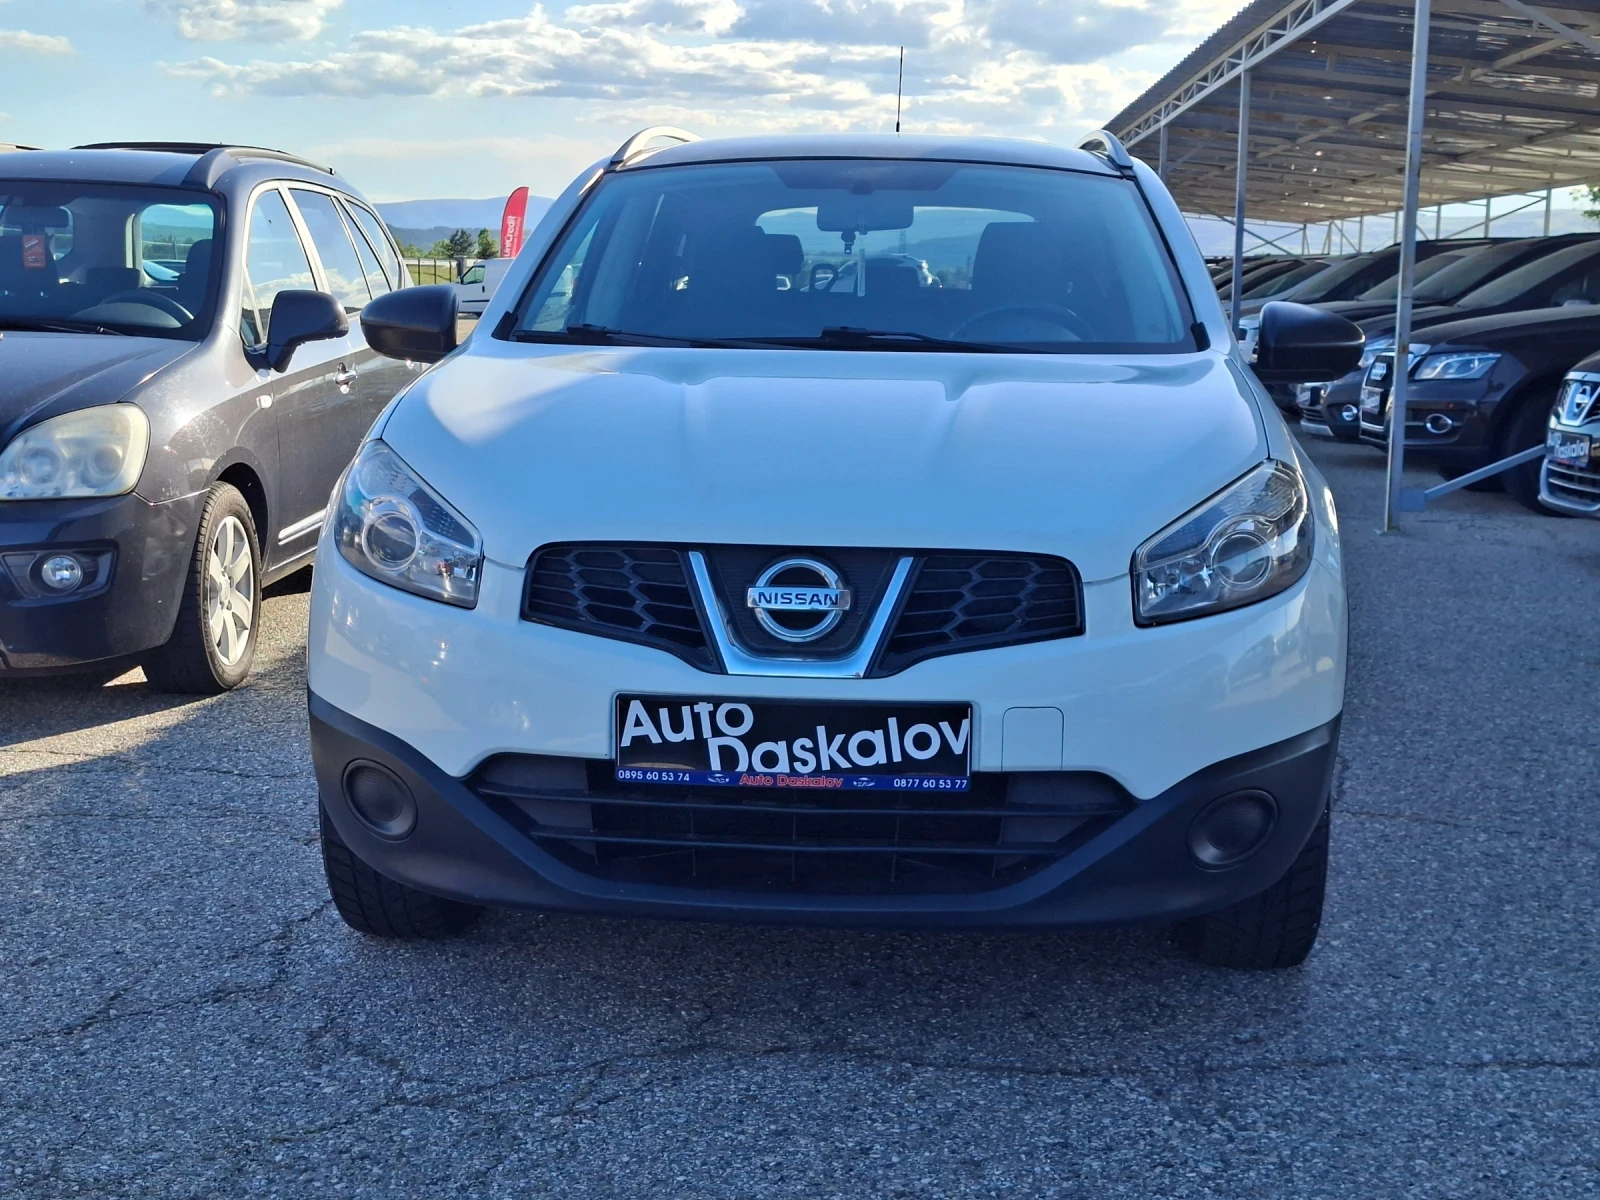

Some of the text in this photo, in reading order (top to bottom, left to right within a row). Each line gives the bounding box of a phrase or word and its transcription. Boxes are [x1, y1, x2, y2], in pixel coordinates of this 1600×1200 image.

[758, 592, 839, 606] NISSAN
[620, 699, 754, 747] Auto
[707, 716, 970, 774] Daskalov
[618, 769, 690, 782] 0895 60 53 74
[739, 774, 844, 788] Auto Daskalov
[893, 778, 968, 789] 0877 60 53 77
